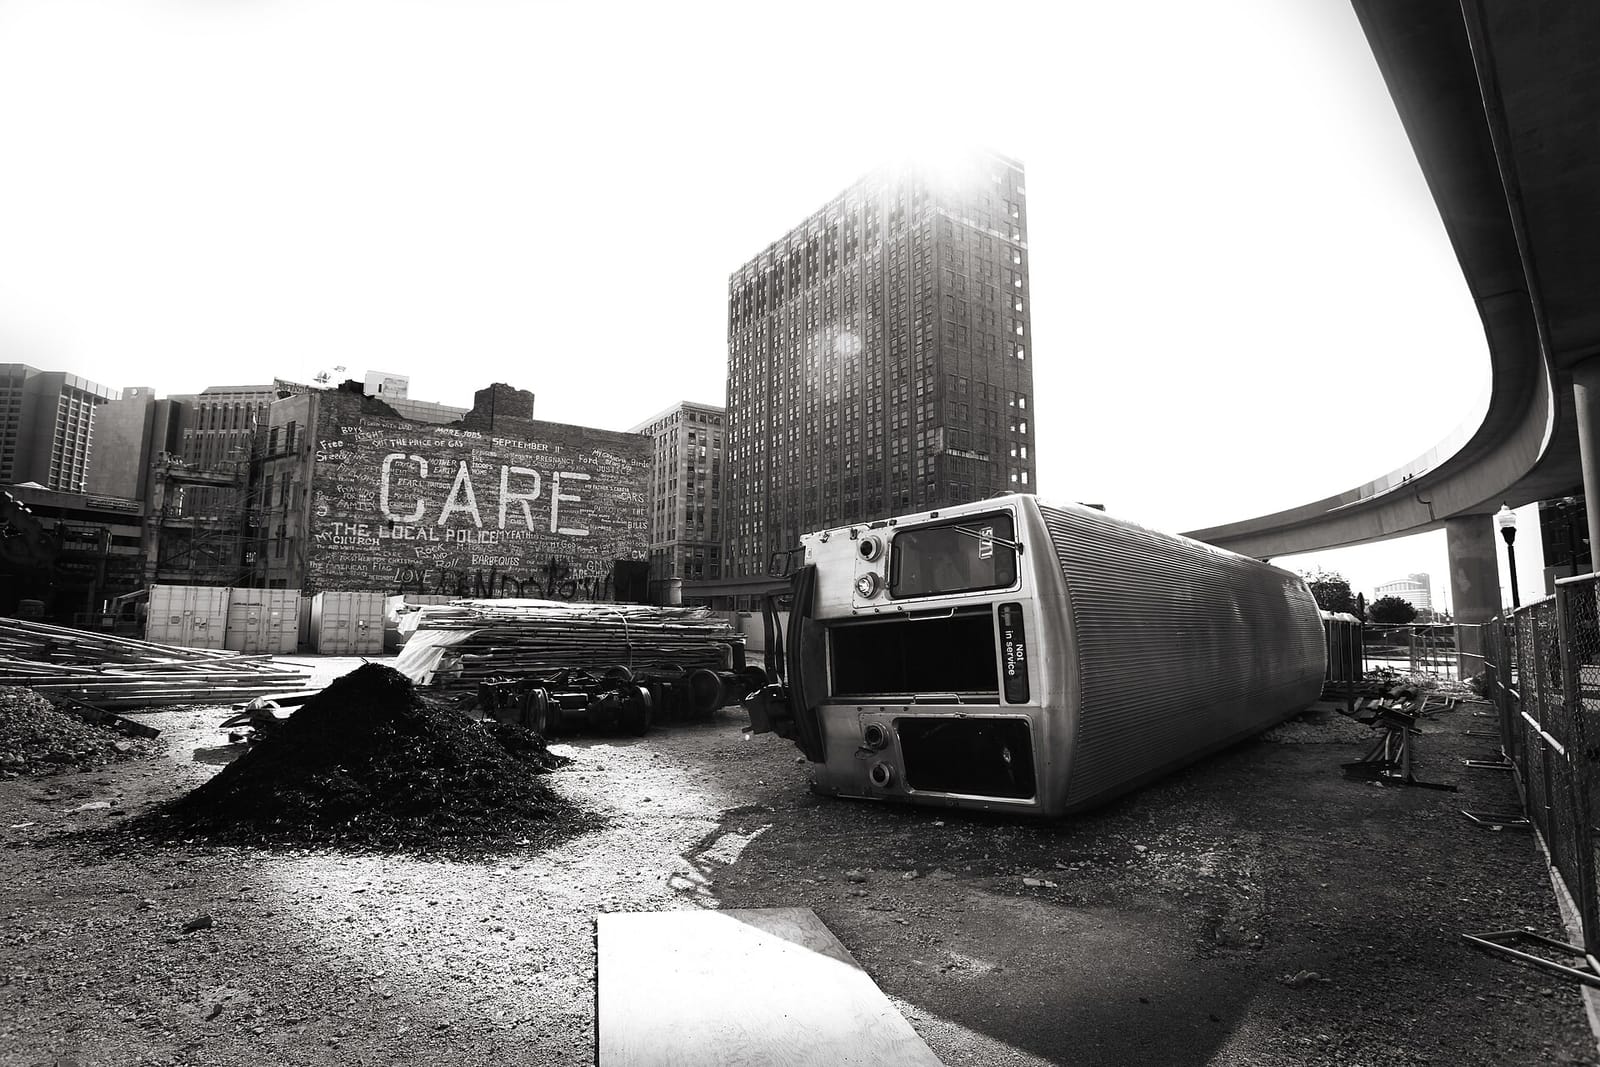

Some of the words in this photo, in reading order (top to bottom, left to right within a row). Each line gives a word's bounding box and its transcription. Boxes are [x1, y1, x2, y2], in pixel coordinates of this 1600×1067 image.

[435, 427, 460, 437] MORE
[434, 440, 446, 448] OF
[448, 440, 464, 448] GAS
[492, 437, 549, 452] SEPTEMBER
[378, 453, 592, 537] CARE
[314, 531, 333, 542] MY
[330, 521, 370, 537] THE
[379, 523, 440, 541] LOCAL
[445, 529, 499, 544] POLICE
[333, 535, 381, 546] CHURCH
[392, 567, 435, 584] LOVE
[1005, 630, 1014, 639] in
[1006, 641, 1016, 676] service
[1015, 643, 1024, 661] Not
